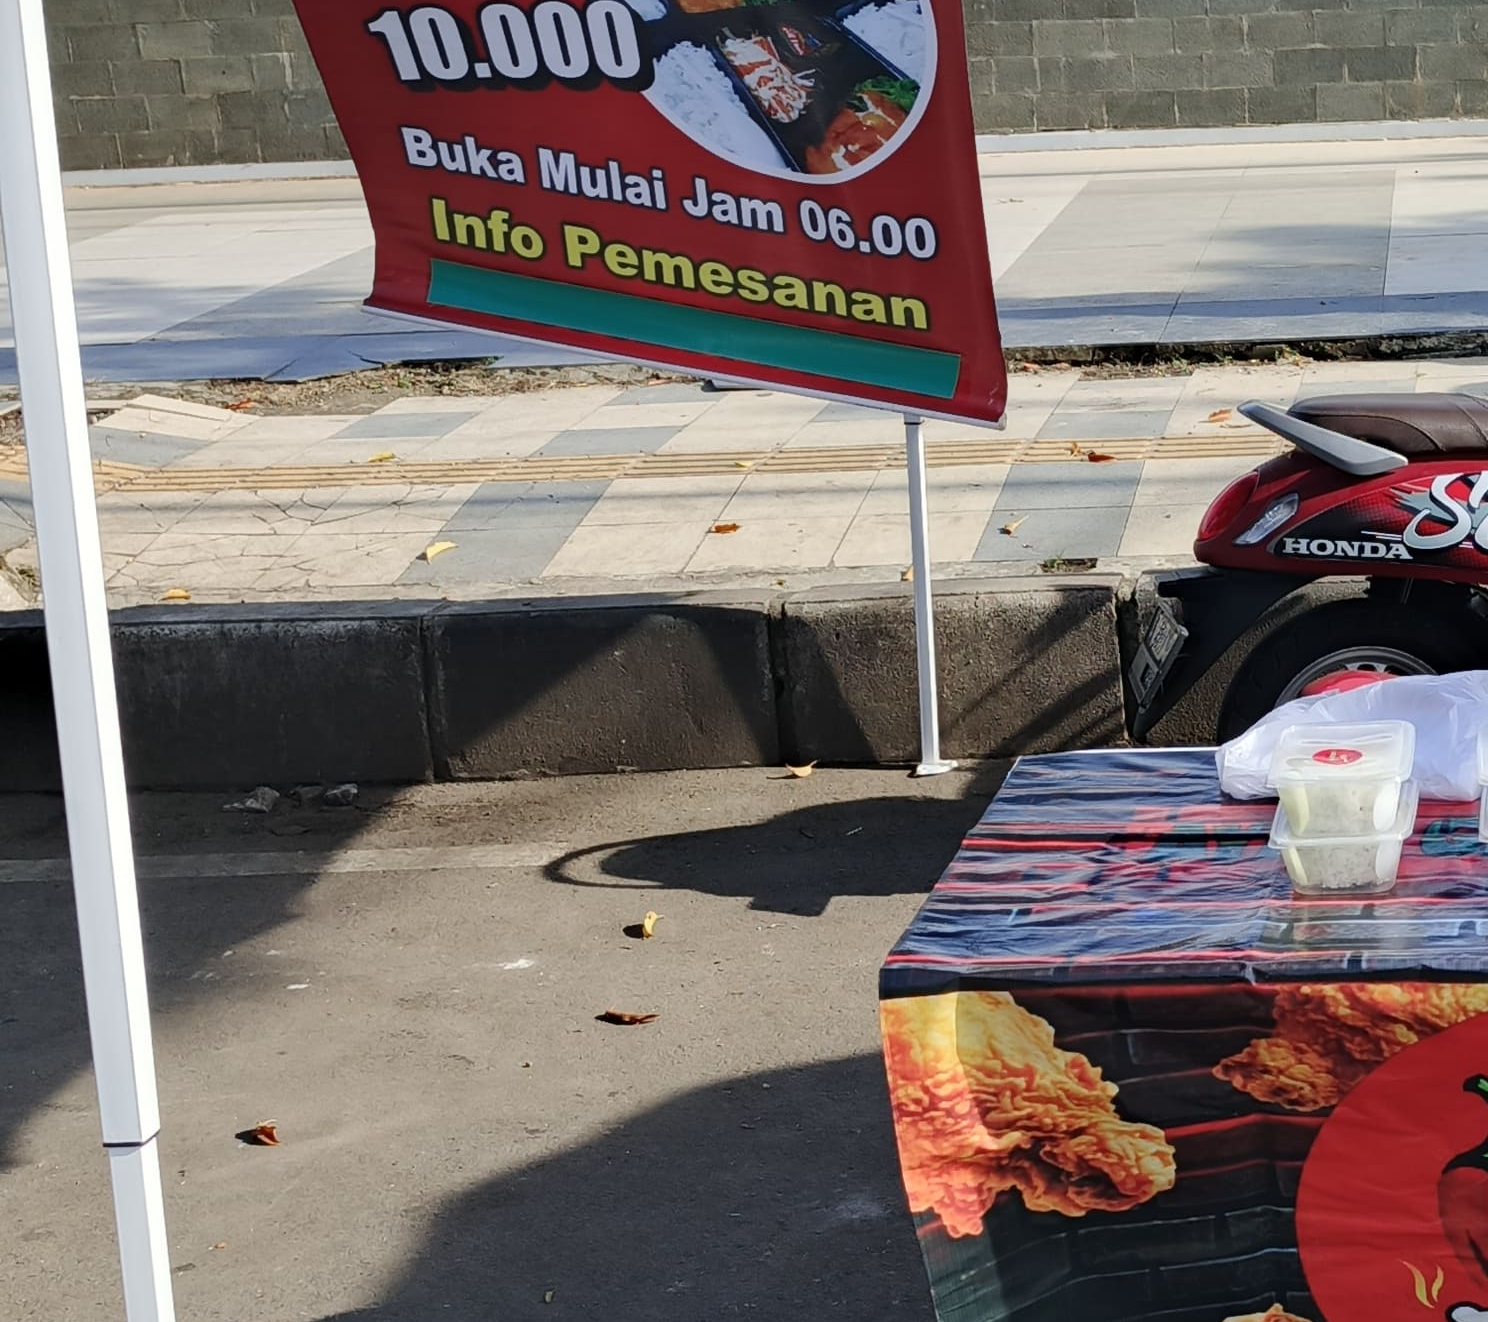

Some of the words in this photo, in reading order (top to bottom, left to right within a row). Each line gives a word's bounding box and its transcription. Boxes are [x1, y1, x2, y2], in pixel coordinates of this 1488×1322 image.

[367, 0, 642, 82] 10.000
[400, 125, 526, 184] Buka
[538, 147, 667, 210] Mulai
[682, 177, 785, 234] Jam
[799, 199, 937, 259] 06.00
[430, 197, 545, 259] Info
[562, 224, 930, 331] Pemesanan
[1282, 536, 1414, 561] HONDA
